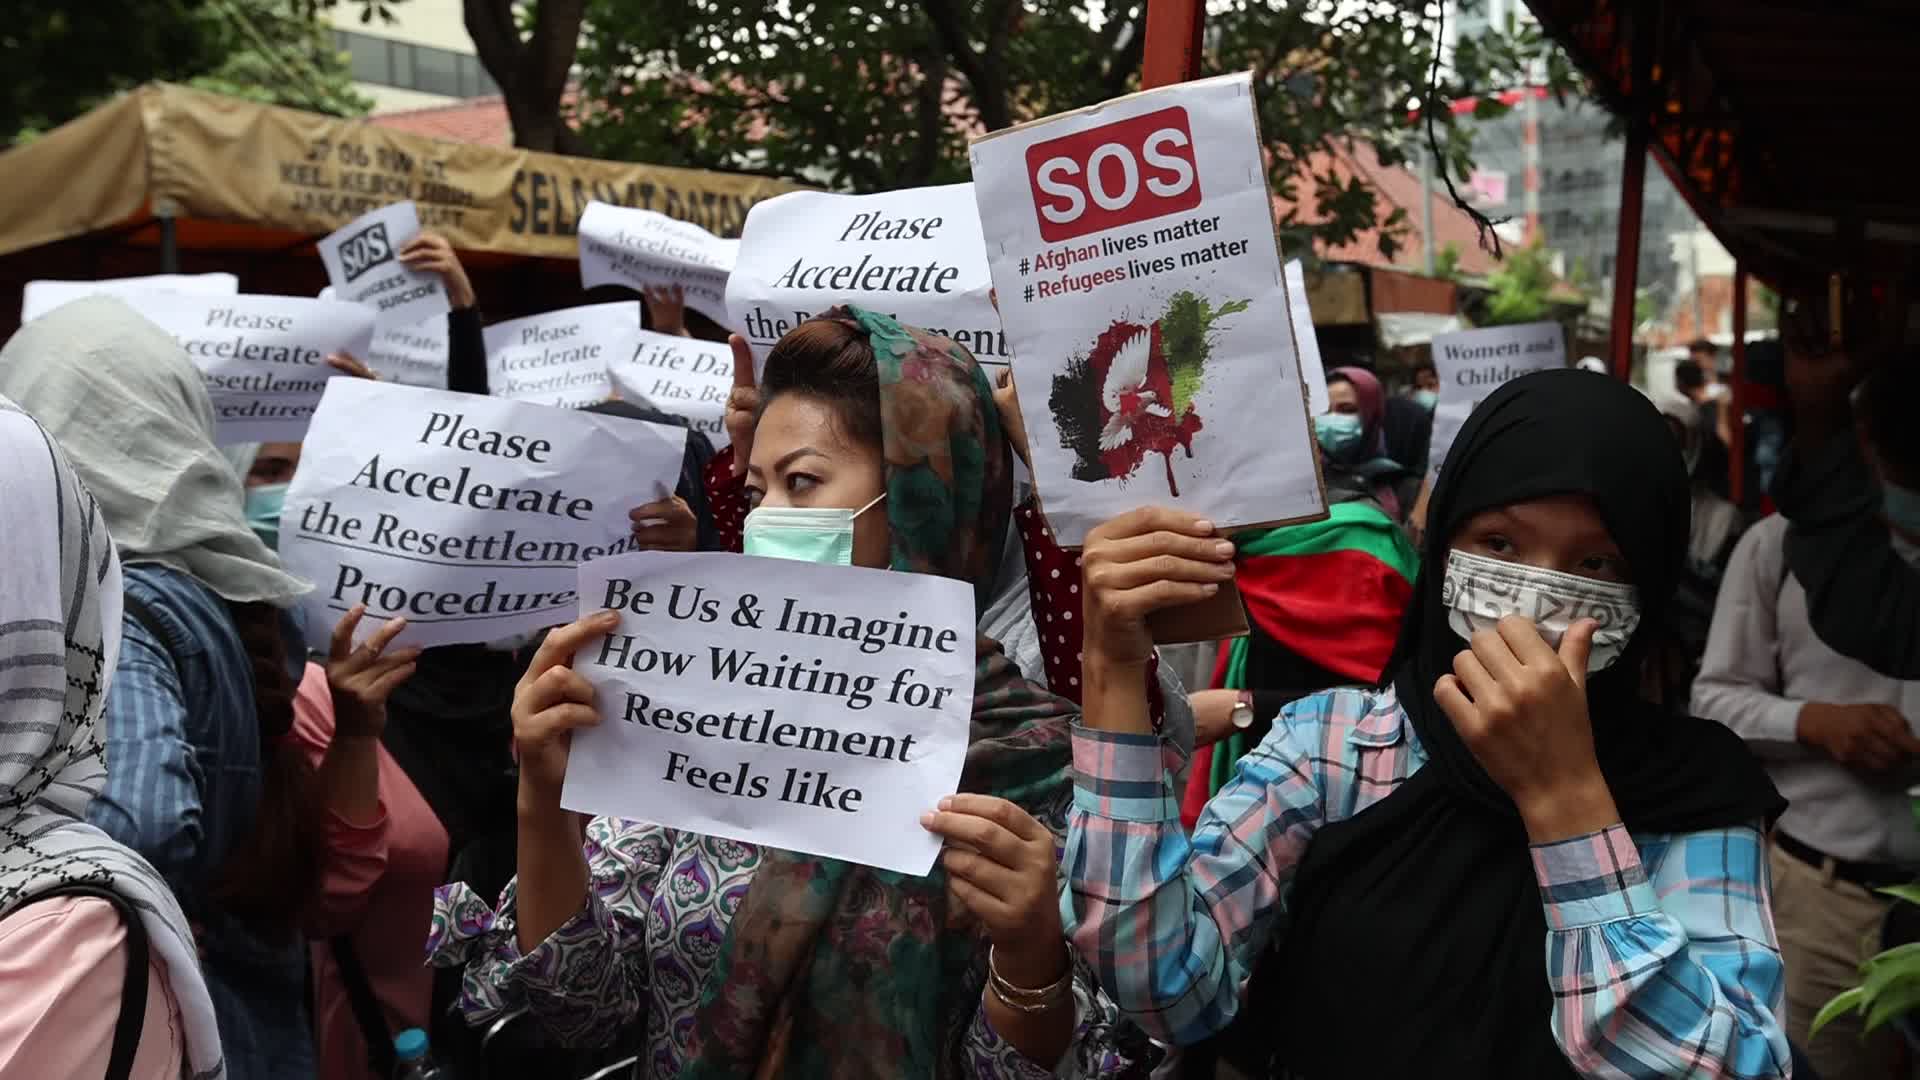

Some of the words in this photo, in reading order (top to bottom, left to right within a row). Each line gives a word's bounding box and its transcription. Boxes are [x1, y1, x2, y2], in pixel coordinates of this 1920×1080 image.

[1036, 128, 1194, 224] SOS
[664, 185, 768, 239] DATAN
[840, 210, 943, 242] Please
[341, 225, 391, 278] SOS
[609, 229, 727, 265] Accelerate
[1034, 242, 1099, 273] Afghan
[1101, 232, 1148, 256] lives
[1153, 216, 1221, 245] matter
[771, 254, 960, 294] Accelerate
[1037, 264, 1126, 298] Refugees
[1128, 256, 1175, 279] lives
[1180, 239, 1249, 268] matter
[352, 274, 406, 302] UGEES
[377, 281, 437, 312] SUICIDE
[205, 307, 293, 331] Please
[521, 322, 580, 345] Please
[744, 306, 789, 339] the
[182, 336, 320, 366] ccelerate
[496, 344, 602, 374] Accelerate
[631, 342, 685, 370] Life
[691, 352, 735, 377] Da
[1444, 341, 1521, 361] Women
[1525, 338, 1555, 353] and
[208, 371, 326, 393] settleme
[504, 368, 607, 395] Resettleme
[650, 379, 691, 401] Has
[700, 382, 728, 404] Be
[1456, 364, 1542, 387] Childr
[215, 401, 316, 418] edures
[418, 412, 552, 464] Please
[349, 453, 594, 521] Accelerate
[300, 501, 361, 540] the
[371, 512, 640, 563] Resettlement
[329, 563, 580, 616] Procedure
[600, 578, 655, 615] Be
[668, 584, 720, 623] Us
[730, 593, 763, 630] &
[775, 597, 958, 654] Imagine
[593, 632, 697, 677] How
[708, 646, 880, 710] Waiting
[886, 668, 953, 711] for
[622, 691, 917, 763] Resettlement
[662, 750, 769, 799] Feels
[778, 767, 863, 813] like
